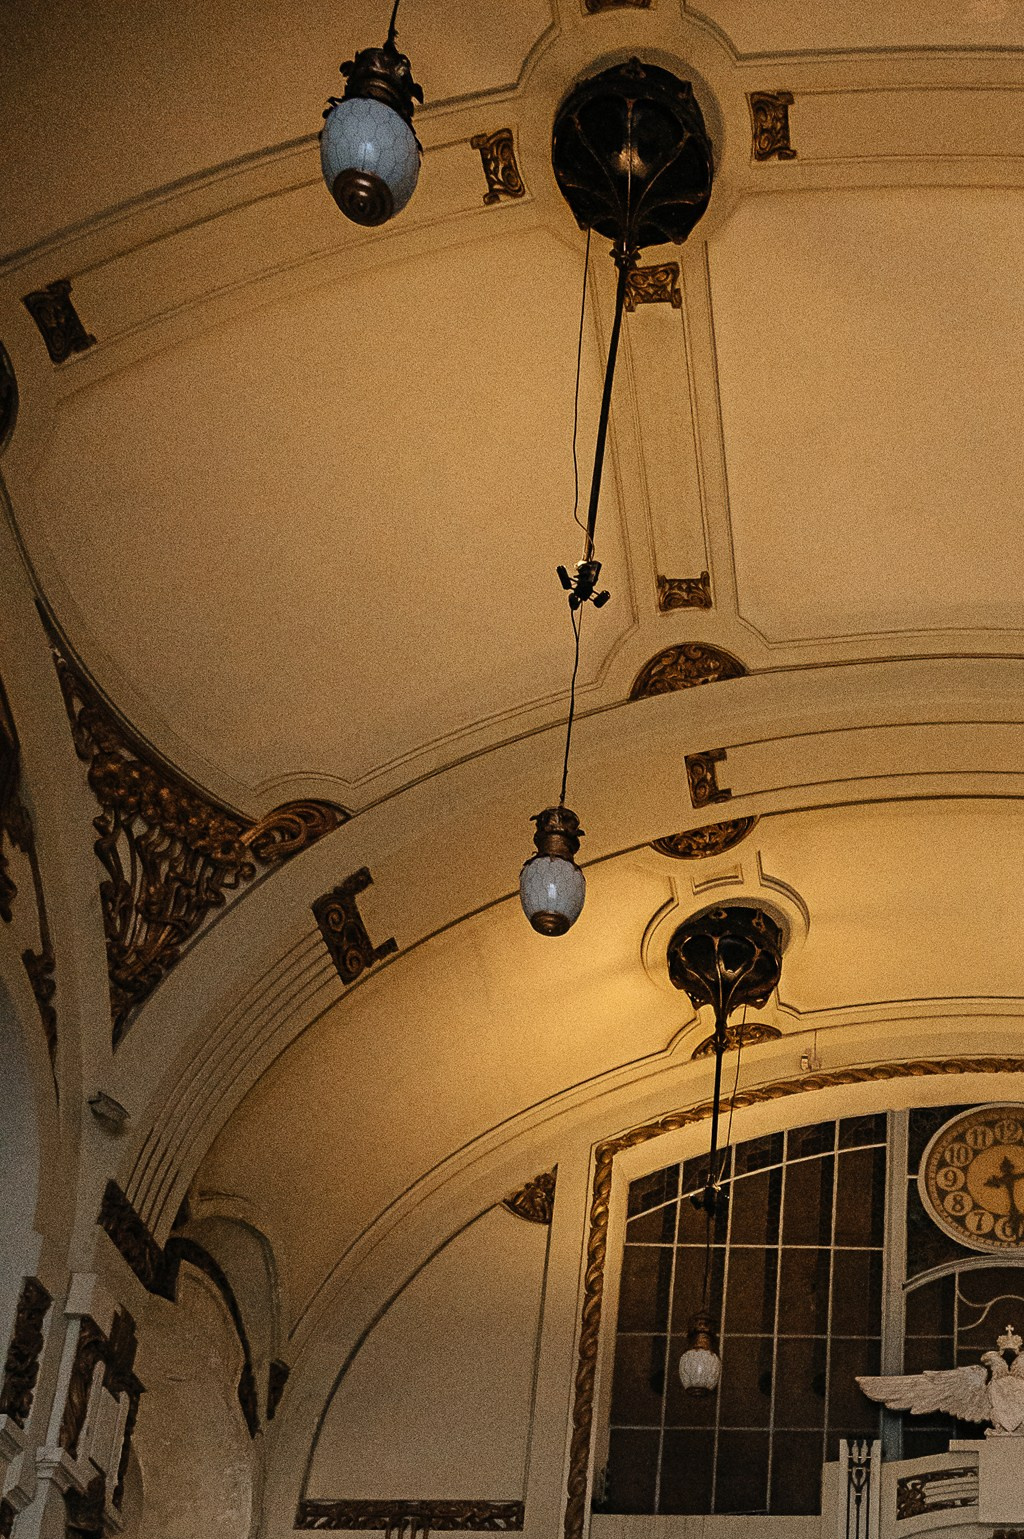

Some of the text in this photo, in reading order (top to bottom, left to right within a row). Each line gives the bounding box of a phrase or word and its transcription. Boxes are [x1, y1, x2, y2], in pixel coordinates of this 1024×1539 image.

[972, 1129, 988, 1147] 11
[1001, 1120, 1018, 1138] 12
[949, 1147, 968, 1164] 10
[943, 1169, 957, 1189] 9
[952, 1194, 965, 1212] 8
[970, 1213, 985, 1230] 7
